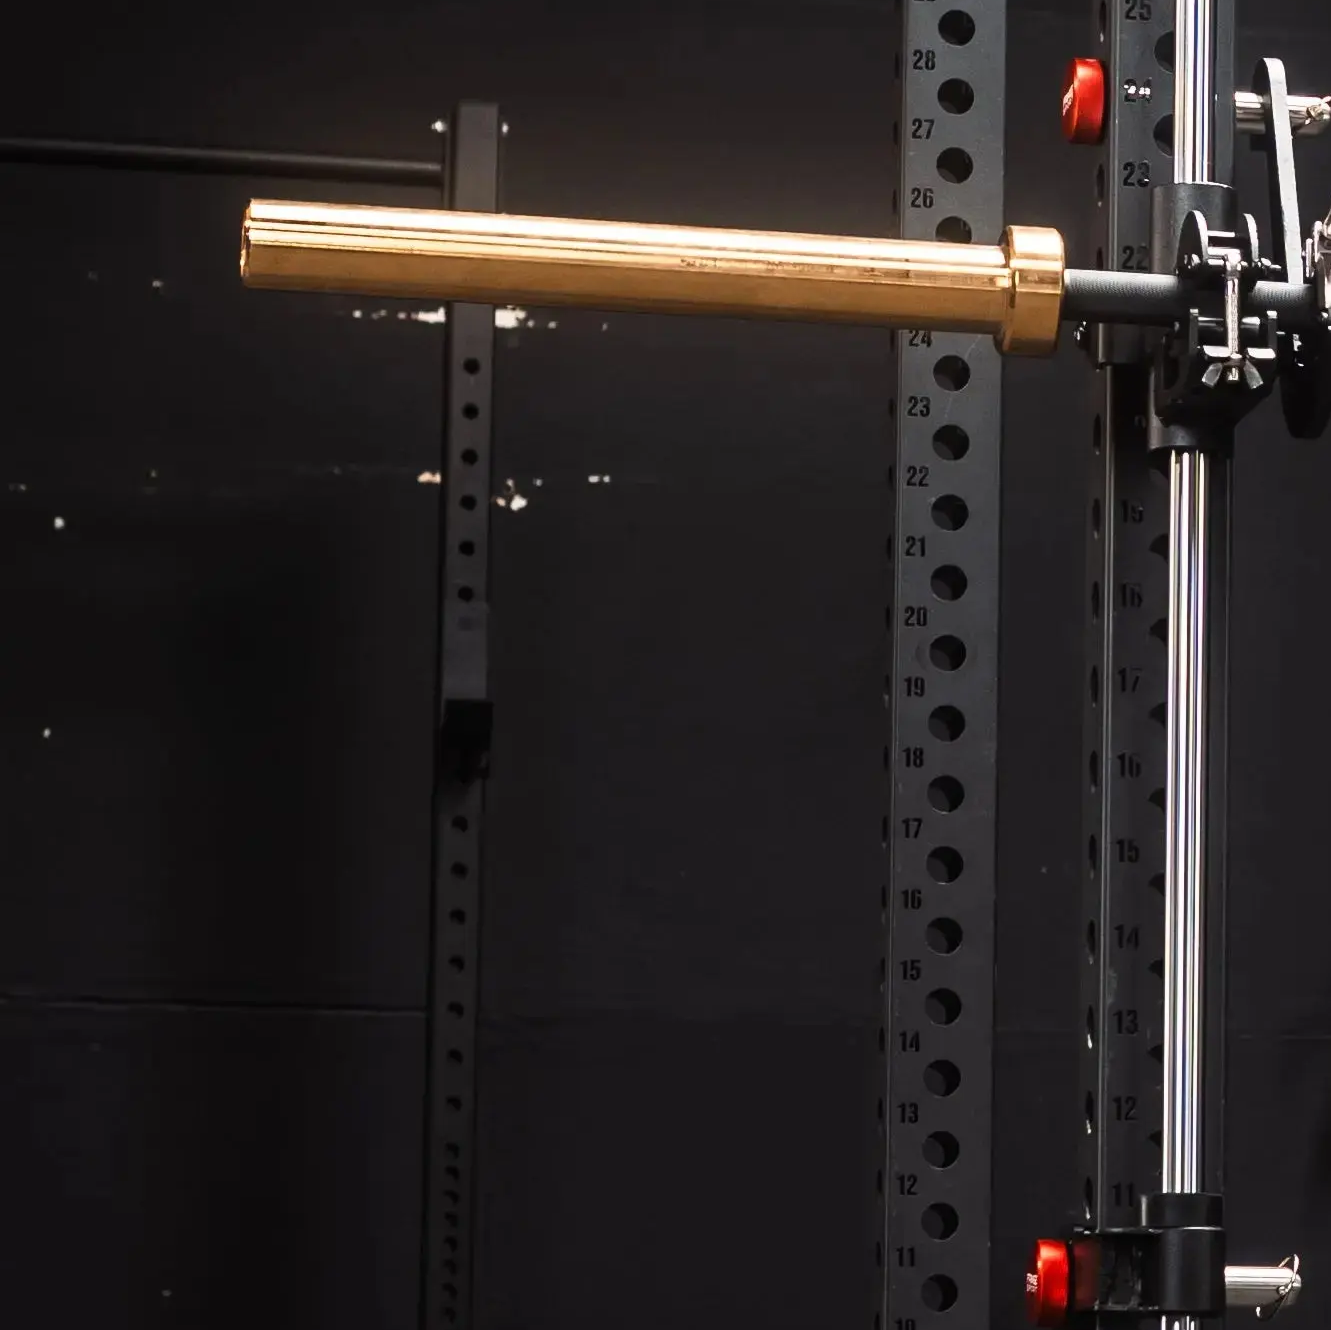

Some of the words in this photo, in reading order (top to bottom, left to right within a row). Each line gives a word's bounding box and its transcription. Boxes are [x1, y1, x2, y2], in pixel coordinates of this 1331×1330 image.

[912, 48, 936, 71] 28
[911, 117, 935, 140] 27
[1122, 161, 1150, 188] 23
[910, 186, 934, 209] 26
[1122, 245, 1151, 272] 22
[908, 328, 933, 349] 24
[907, 395, 931, 418] 23
[906, 465, 930, 488] 22
[904, 535, 926, 558] 21
[904, 605, 928, 627] 20
[903, 676, 926, 698] 19
[1117, 667, 1142, 693] 17
[902, 746, 924, 769] 18
[901, 817, 923, 840] 17
[1115, 838, 1140, 864] 15
[901, 888, 923, 910] 16
[1114, 923, 1140, 951] 14
[899, 959, 922, 982] 15
[1112, 1009, 1139, 1035] 13
[898, 1030, 921, 1053] 14
[897, 1102, 919, 1124] 13
[1112, 1095, 1138, 1122] 12
[896, 1173, 918, 1196] 12
[1111, 1179, 1136, 1207] 11
[896, 1246, 916, 1268] 11
